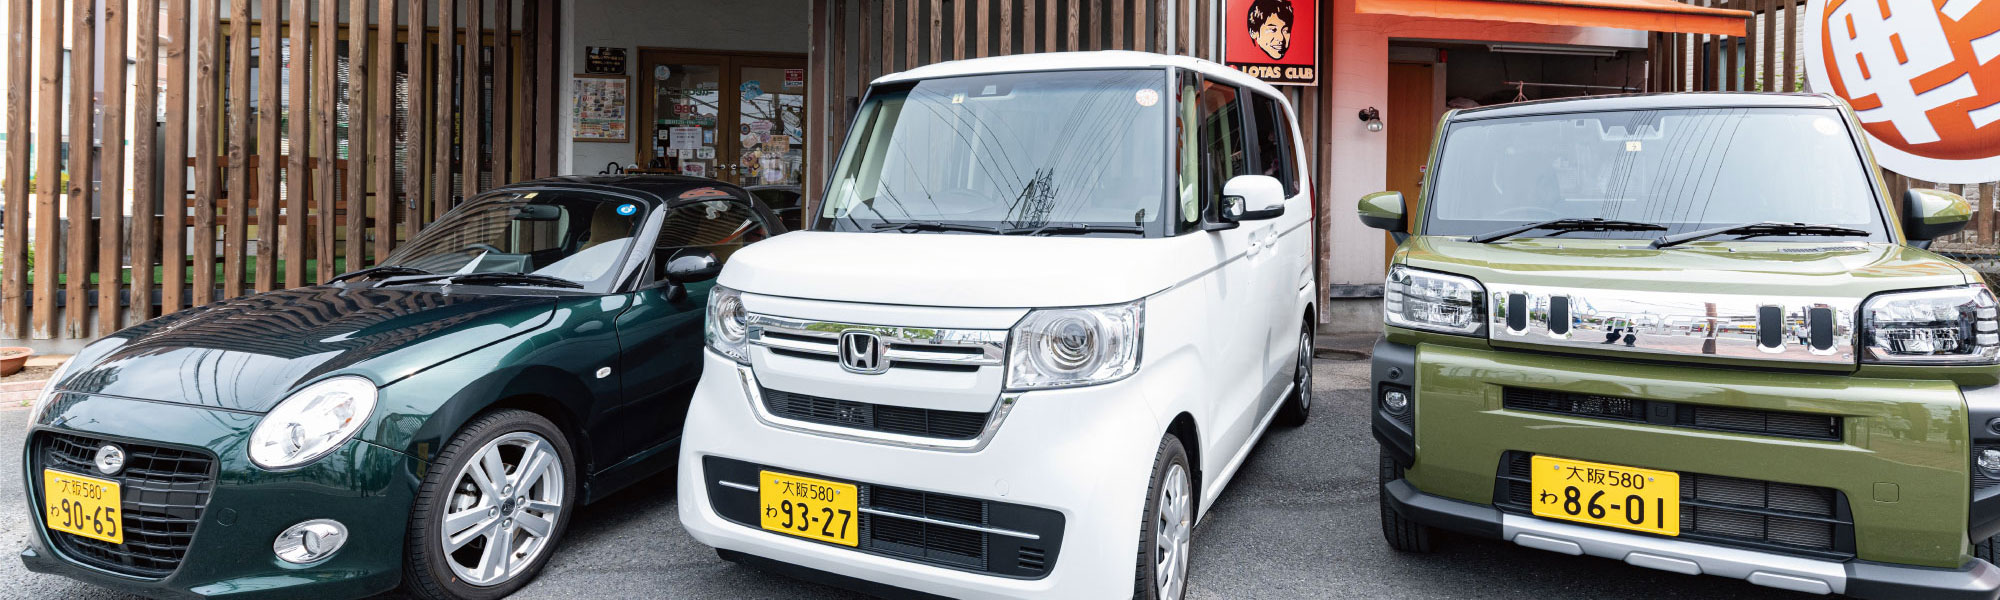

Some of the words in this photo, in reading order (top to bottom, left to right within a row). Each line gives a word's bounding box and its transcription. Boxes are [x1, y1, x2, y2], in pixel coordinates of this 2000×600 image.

[1285, 67, 1313, 79] CLUB
[61, 479, 102, 500] 大阪580
[1566, 466, 1645, 490] 大阪580
[782, 481, 834, 503] 大阪580
[50, 504, 60, 517] わ
[61, 498, 116, 537] 90-65
[1539, 489, 1558, 504] わ
[1563, 485, 1664, 529] 86-01
[766, 503, 778, 518] わ
[781, 500, 851, 539] 93-27
